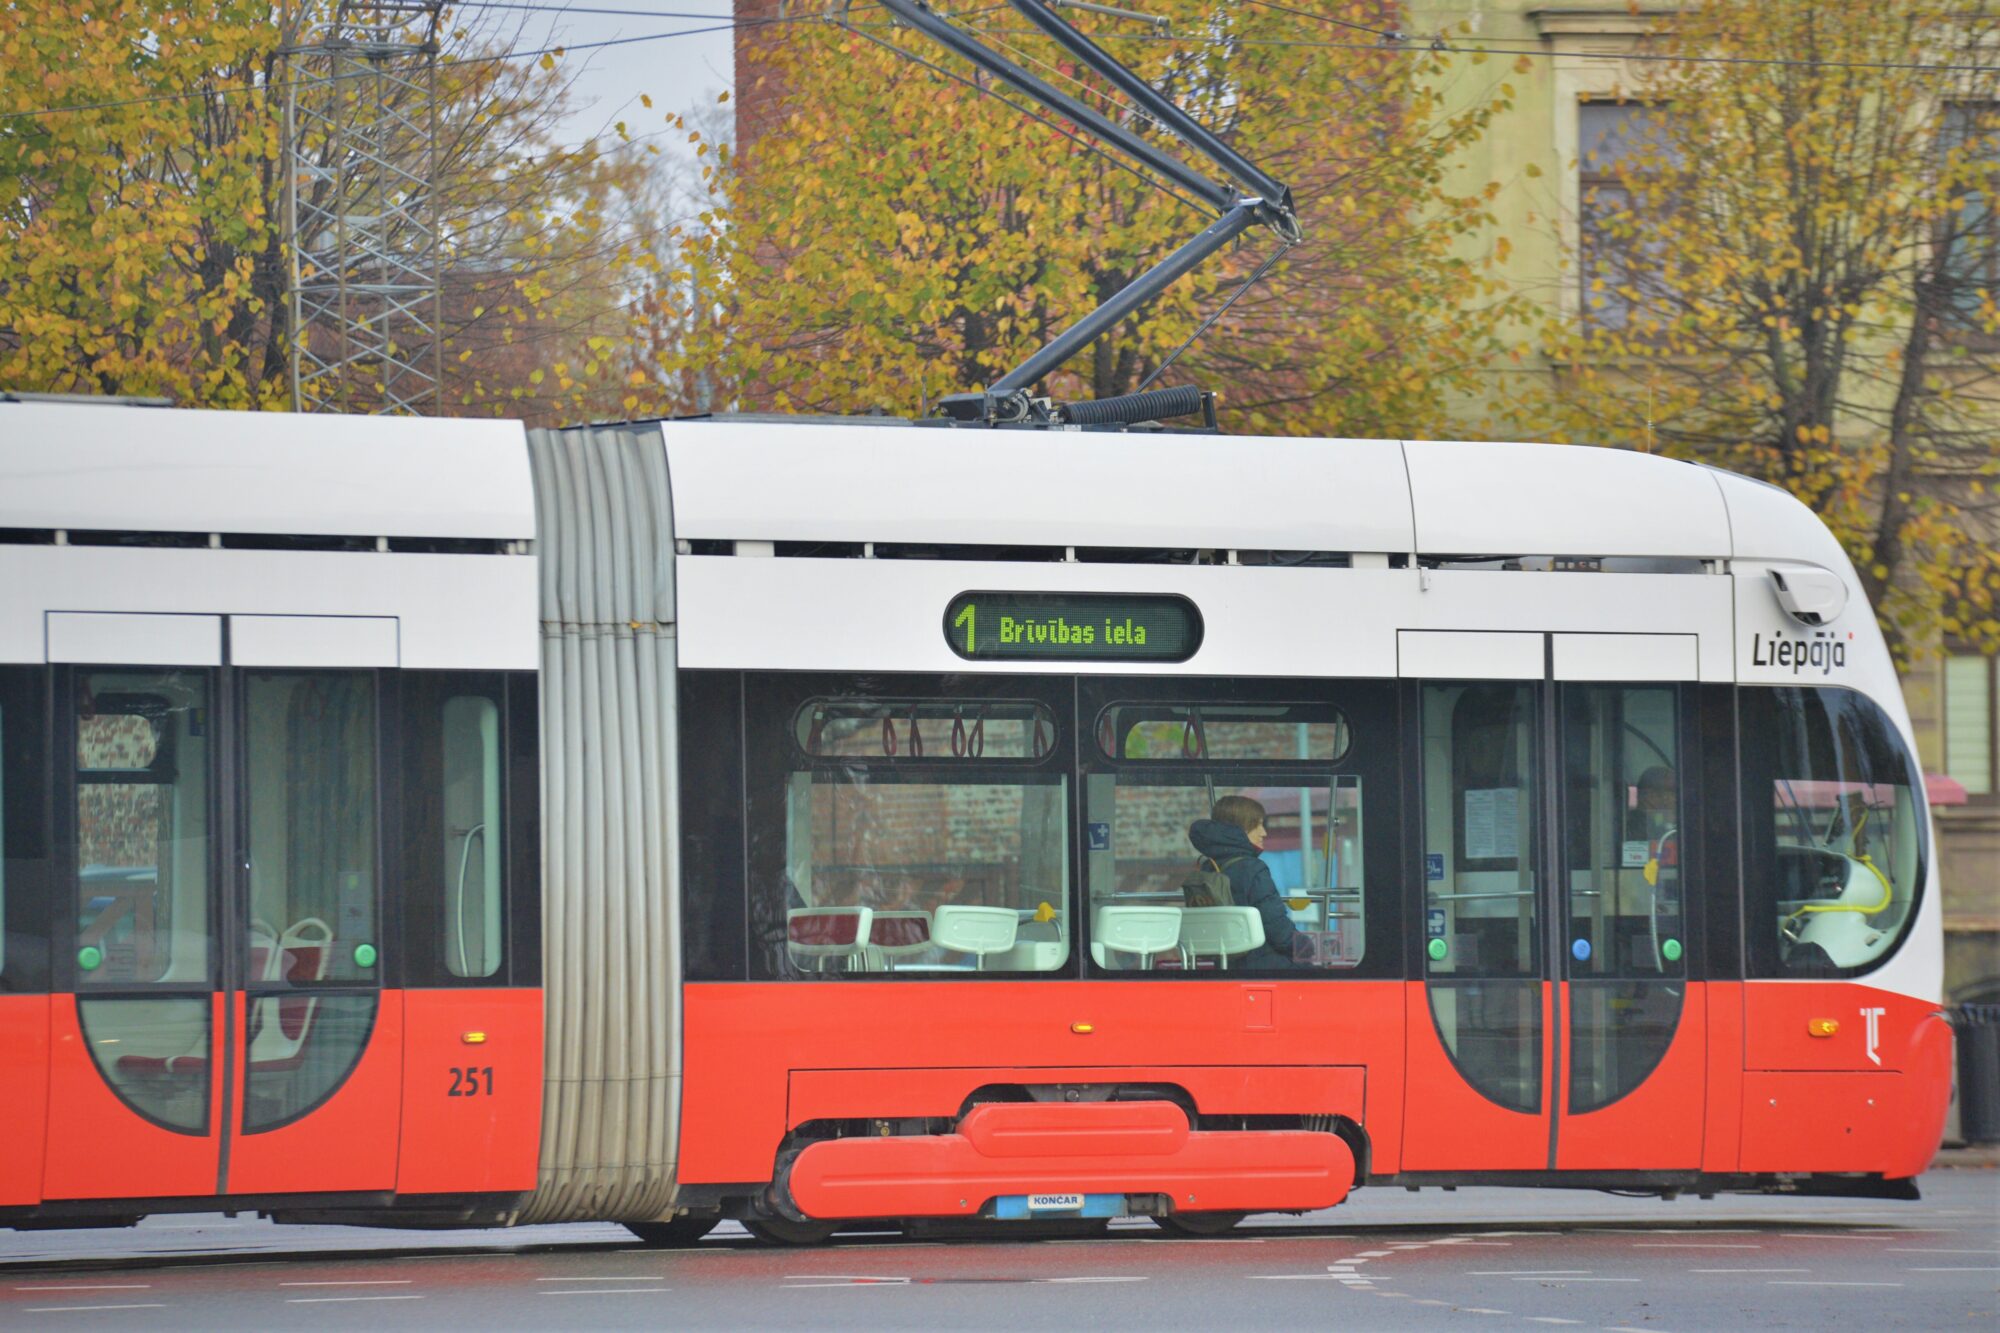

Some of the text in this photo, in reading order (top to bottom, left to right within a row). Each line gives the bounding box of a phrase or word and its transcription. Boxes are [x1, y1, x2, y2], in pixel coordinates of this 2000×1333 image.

[955, 604, 1147, 652] 1 Brīvības iela
[1752, 630, 1845, 675] Liepāja
[447, 1066, 493, 1097] 251
